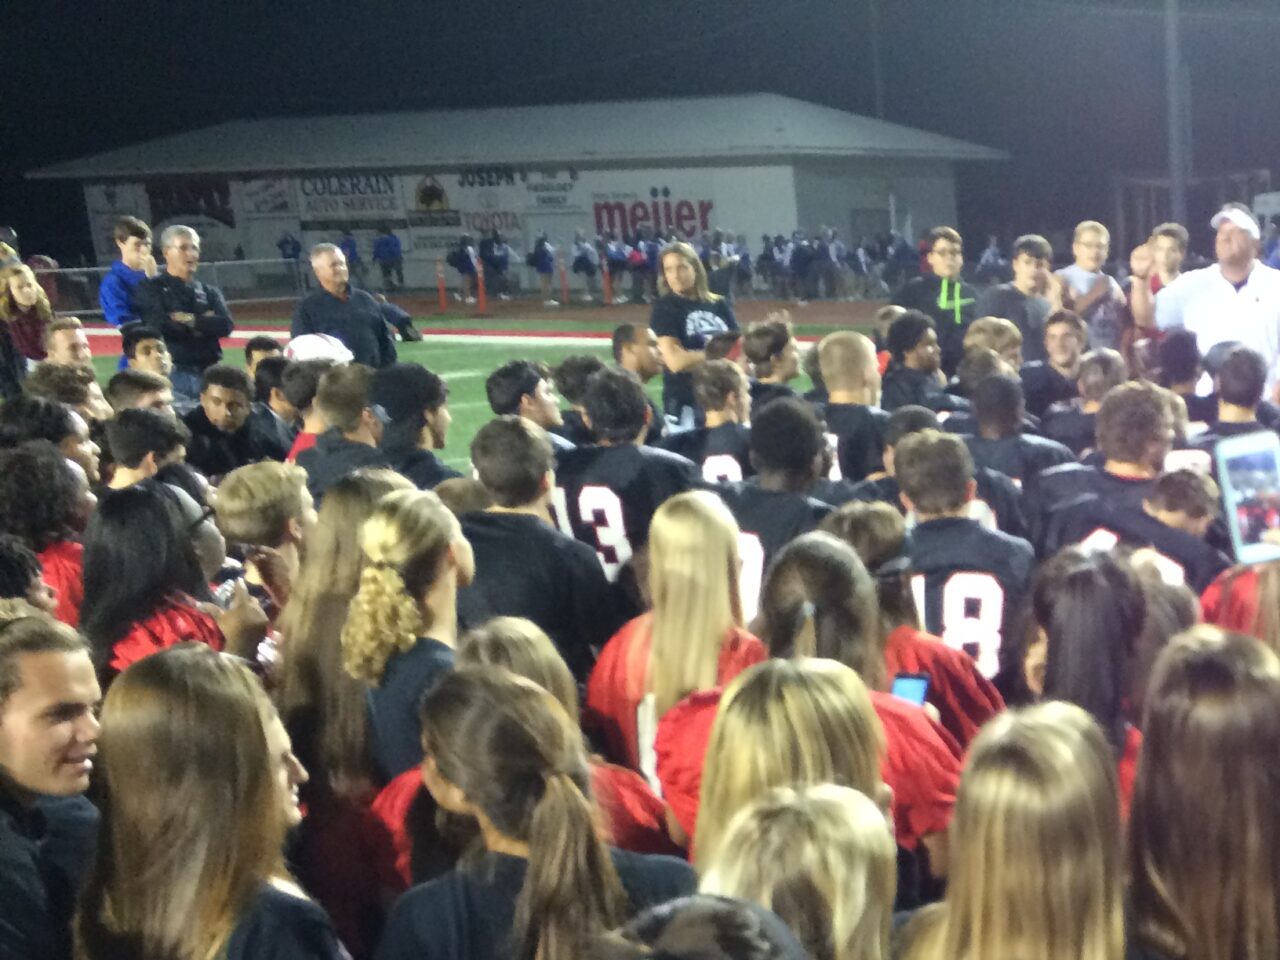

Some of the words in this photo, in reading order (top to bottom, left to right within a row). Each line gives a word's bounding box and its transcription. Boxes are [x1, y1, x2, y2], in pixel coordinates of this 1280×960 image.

[301, 174, 395, 196] COLERAIN
[462, 209, 521, 233] TOYOTA
[593, 185, 713, 239] meijer
